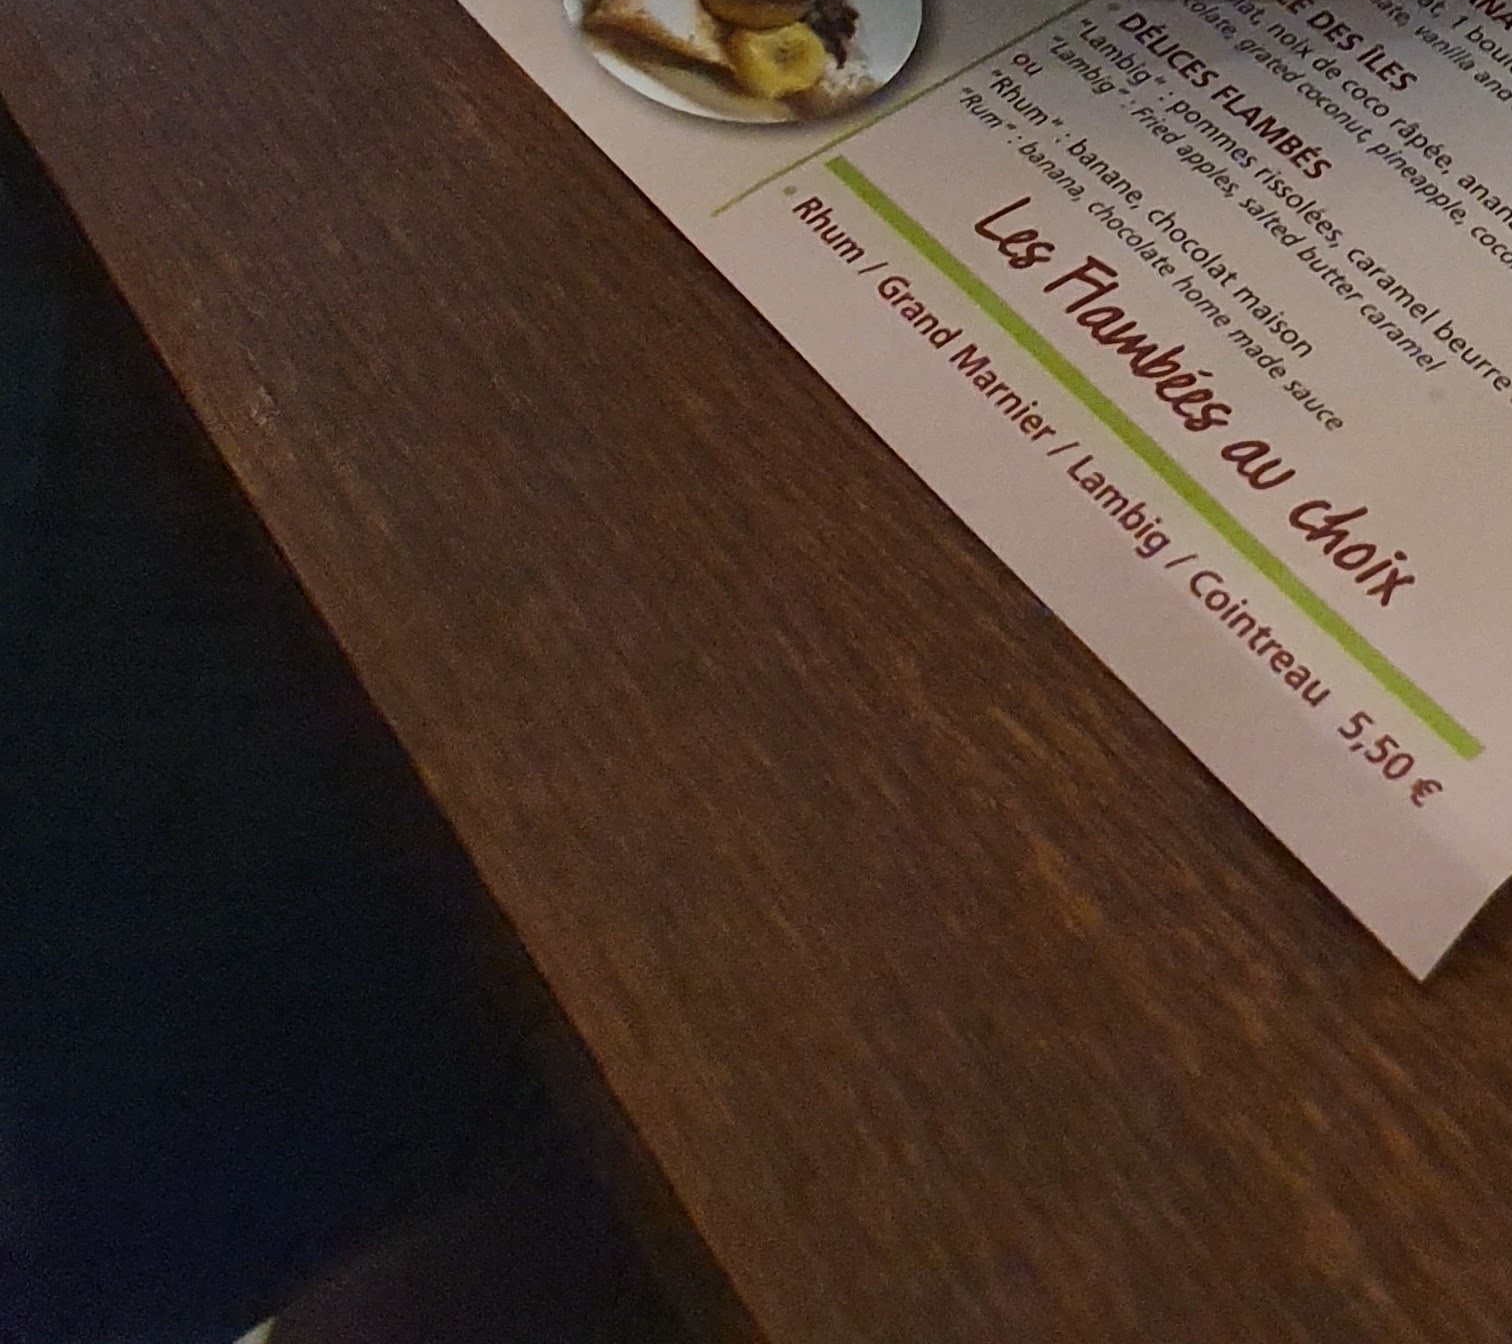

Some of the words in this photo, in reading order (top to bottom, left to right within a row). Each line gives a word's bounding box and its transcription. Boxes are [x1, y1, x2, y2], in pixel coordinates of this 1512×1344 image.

[1010, 53, 1043, 78] ou
[1117, 12, 1220, 88] DÉLICES
[1210, 84, 1333, 179] FLAMBÉS
[1266, 23, 1314, 59] noix
[1312, 58, 1342, 80] de
[1341, 79, 1390, 118] coco
[1389, 117, 1453, 175] râpée,
[1306, 10, 1364, 51] DES
[1356, 44, 1418, 92] ÎLES
[1414, 25, 1475, 72] vanilla
[1451, 15, 1469, 29] 1
[1233, 39, 1307, 83] grated
[1297, 81, 1373, 144] coconut,
[1365, 142, 1467, 226] pineapple,
[1017, 141, 1085, 202] banana,
[1087, 201, 1176, 278] chocolate
[1171, 275, 1231, 328] home
[1227, 329, 1287, 380] made
[1282, 380, 1344, 432] sauce
[1066, 138, 1143, 210] banane,
[1147, 209, 1238, 289] chocolat
[1232, 286, 1313, 359] maison
[1130, 106, 1186, 145] Fried
[1176, 144, 1240, 198] apples,
[1238, 197, 1307, 247] salted
[1296, 245, 1364, 301] butter
[1359, 304, 1447, 373] caramel
[1164, 99, 1258, 169] pommes
[1253, 167, 1344, 249] rissolées,
[1347, 248, 1441, 326] caramel
[1432, 319, 1512, 392] beurre
[792, 196, 865, 264] Rhum
[877, 276, 963, 350] Grand
[948, 343, 1057, 442] Marnier
[1066, 454, 1171, 559] Lambig
[1189, 570, 1332, 708] Cointreau
[1337, 710, 1415, 781] 5,50
[974, 196, 1056, 270] Les
[1043, 255, 1232, 432] Flambées
[1220, 440, 1296, 490] au
[1288, 499, 1415, 607] choix
